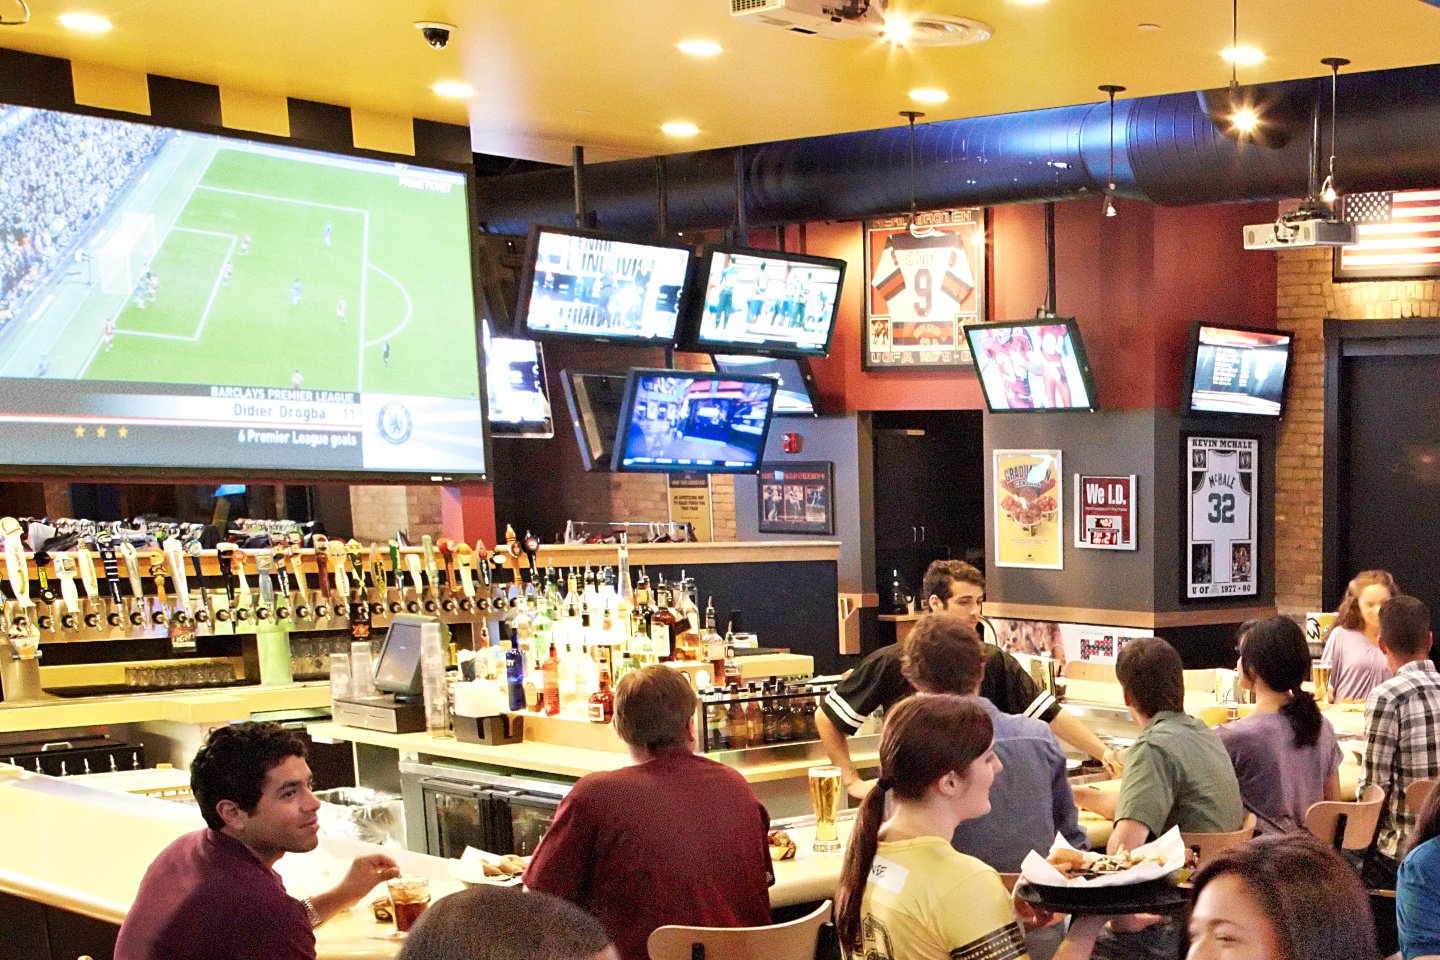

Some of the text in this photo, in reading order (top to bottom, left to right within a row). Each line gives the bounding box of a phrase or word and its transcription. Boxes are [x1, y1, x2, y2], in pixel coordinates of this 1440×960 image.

[914, 269, 932, 317] 9
[211, 386, 354, 404] BARCLAYS PREMIER LEAGUE
[234, 403, 273, 418] Didier
[280, 405, 326, 422] Drogba
[238, 429, 358, 449] 6 Premier League goals
[1192, 439, 1253, 449] KEVIN MCHALE
[1086, 483, 1126, 505] We I.D.
[1208, 493, 1235, 523] 32
